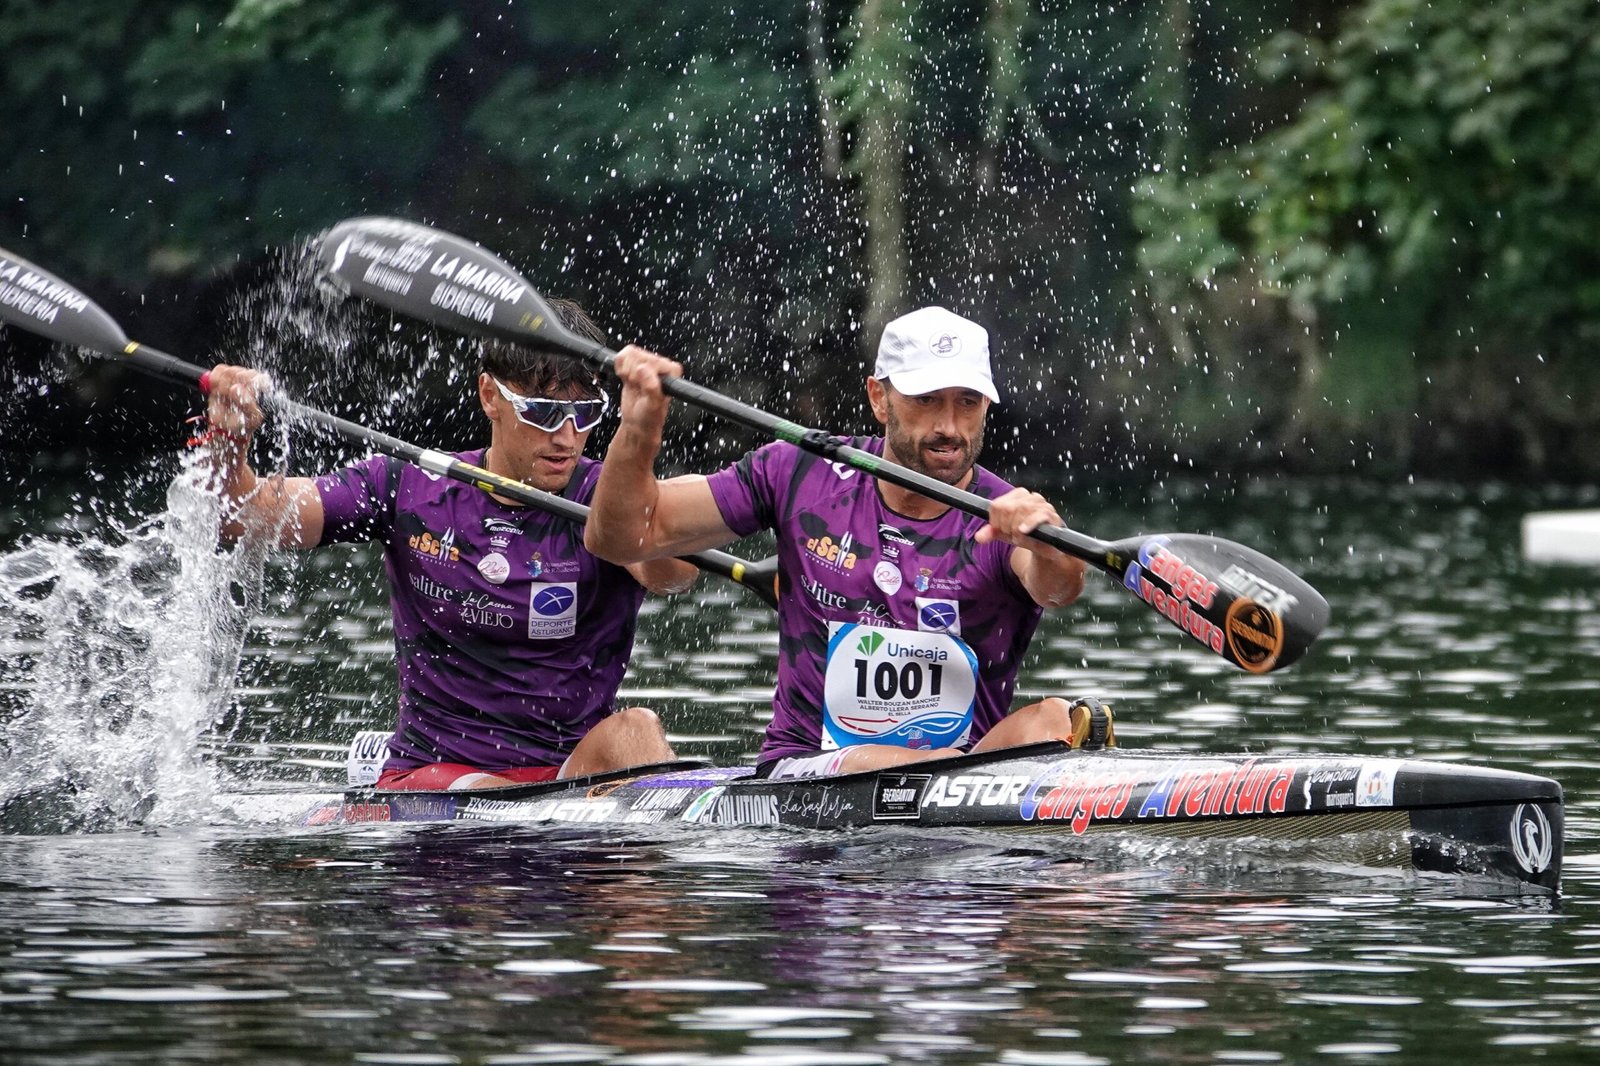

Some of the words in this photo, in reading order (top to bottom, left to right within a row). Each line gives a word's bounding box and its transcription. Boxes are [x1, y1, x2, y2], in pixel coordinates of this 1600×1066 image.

[16, 271, 90, 313] MARINA
[430, 252, 460, 280] LA
[453, 261, 527, 305] MARINA
[408, 572, 454, 602] salitre
[1138, 535, 1220, 611] Cangas
[471, 608, 514, 629] VIEJO
[1124, 559, 1225, 655] Aventura
[531, 620, 574, 628] DEPORTE
[531, 627, 574, 636] ASTURIANO
[887, 642, 949, 661] Unicaja
[854, 658, 943, 700] 1001
[921, 776, 1031, 807] ASTOR
[1021, 760, 1143, 836] Cangas
[1138, 758, 1297, 818] Aventura
[717, 795, 780, 825] SOLUTIONS
